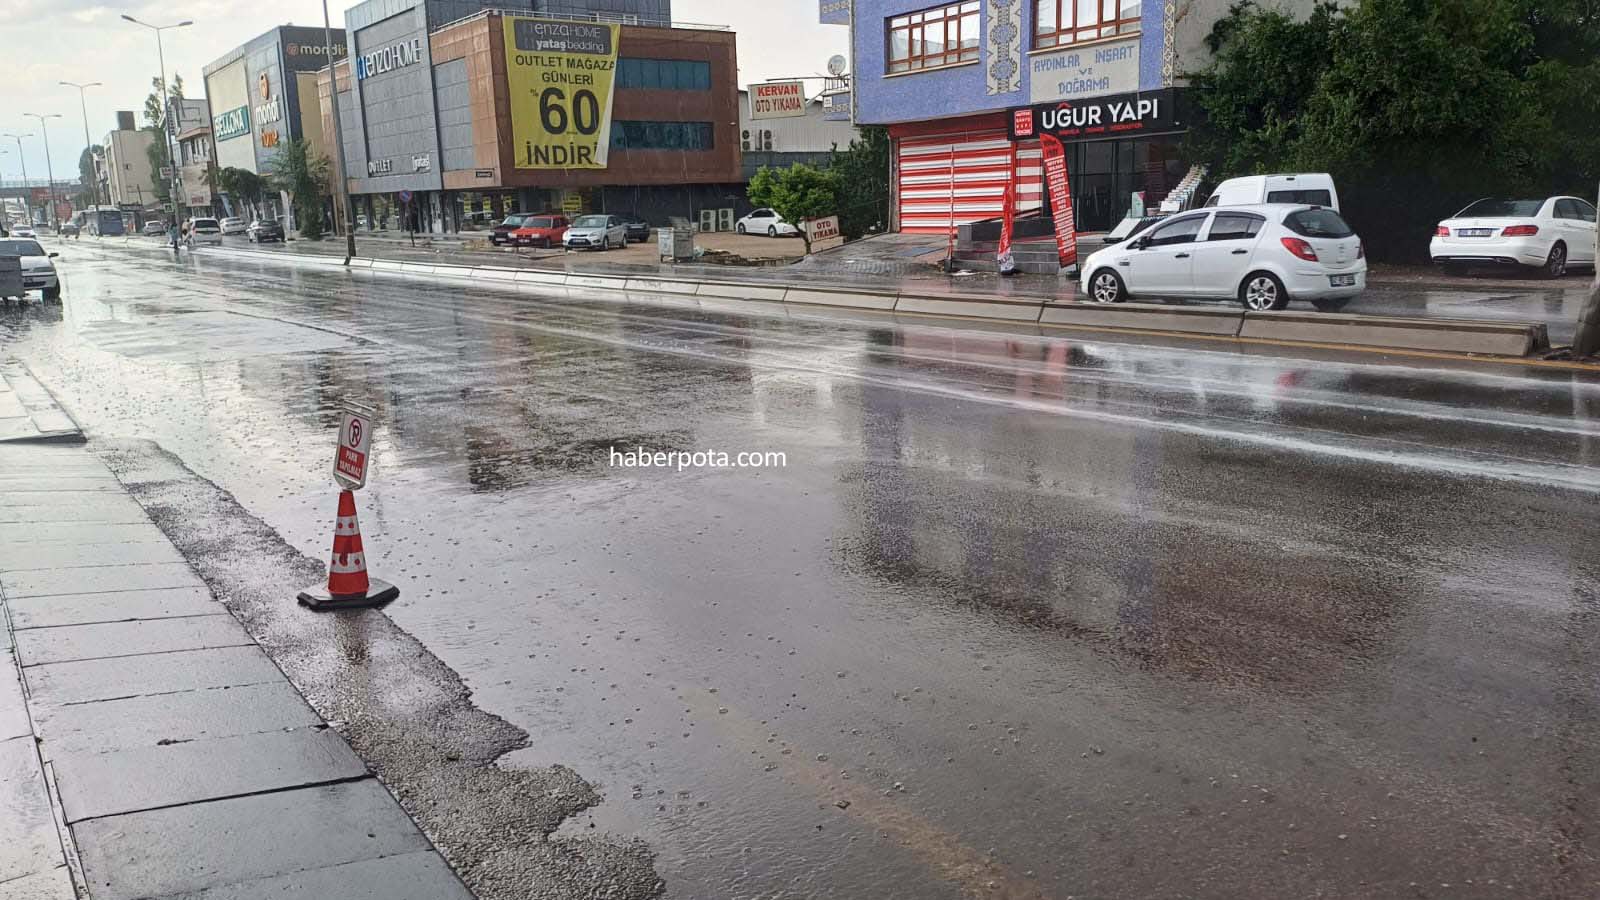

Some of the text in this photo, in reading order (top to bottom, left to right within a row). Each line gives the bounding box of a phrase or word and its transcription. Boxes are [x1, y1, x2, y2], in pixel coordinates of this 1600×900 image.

[515, 54, 562, 67] OUTLET
[1034, 54, 1080, 72] AYDINLAR
[541, 70, 594, 85] GÜNLERİ
[757, 84, 799, 97] KERVAN
[1058, 77, 1110, 95] DOĞRAMA
[755, 97, 802, 113] OTO YIKAMA
[1042, 101, 1101, 129] UĞUR
[1108, 98, 1158, 123] YAPI
[368, 159, 391, 173] OUTLET
[816, 220, 832, 230] OTO
[346, 449, 358, 462] PARK
